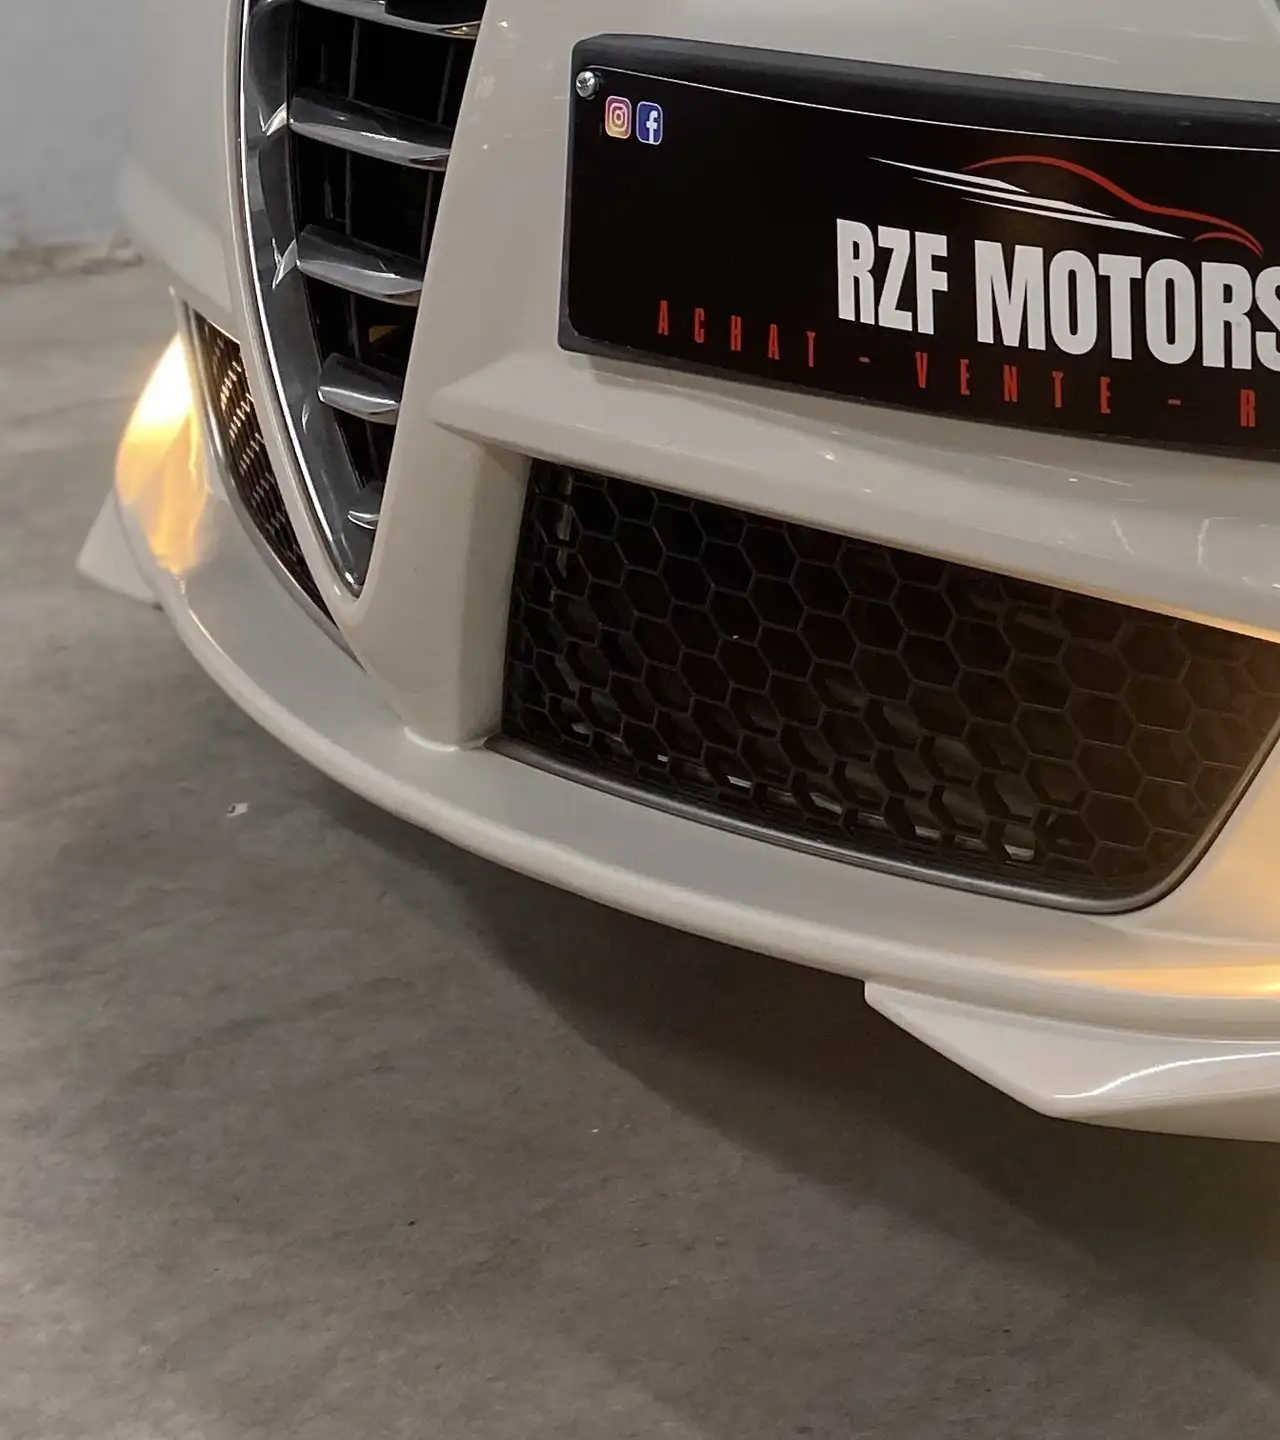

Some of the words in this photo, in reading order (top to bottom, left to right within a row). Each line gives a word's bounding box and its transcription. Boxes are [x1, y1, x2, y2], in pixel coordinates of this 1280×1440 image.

[836, 218, 949, 335] RZF
[656, 299, 817, 368] ACHAT
[914, 350, 1112, 415] VENTE
